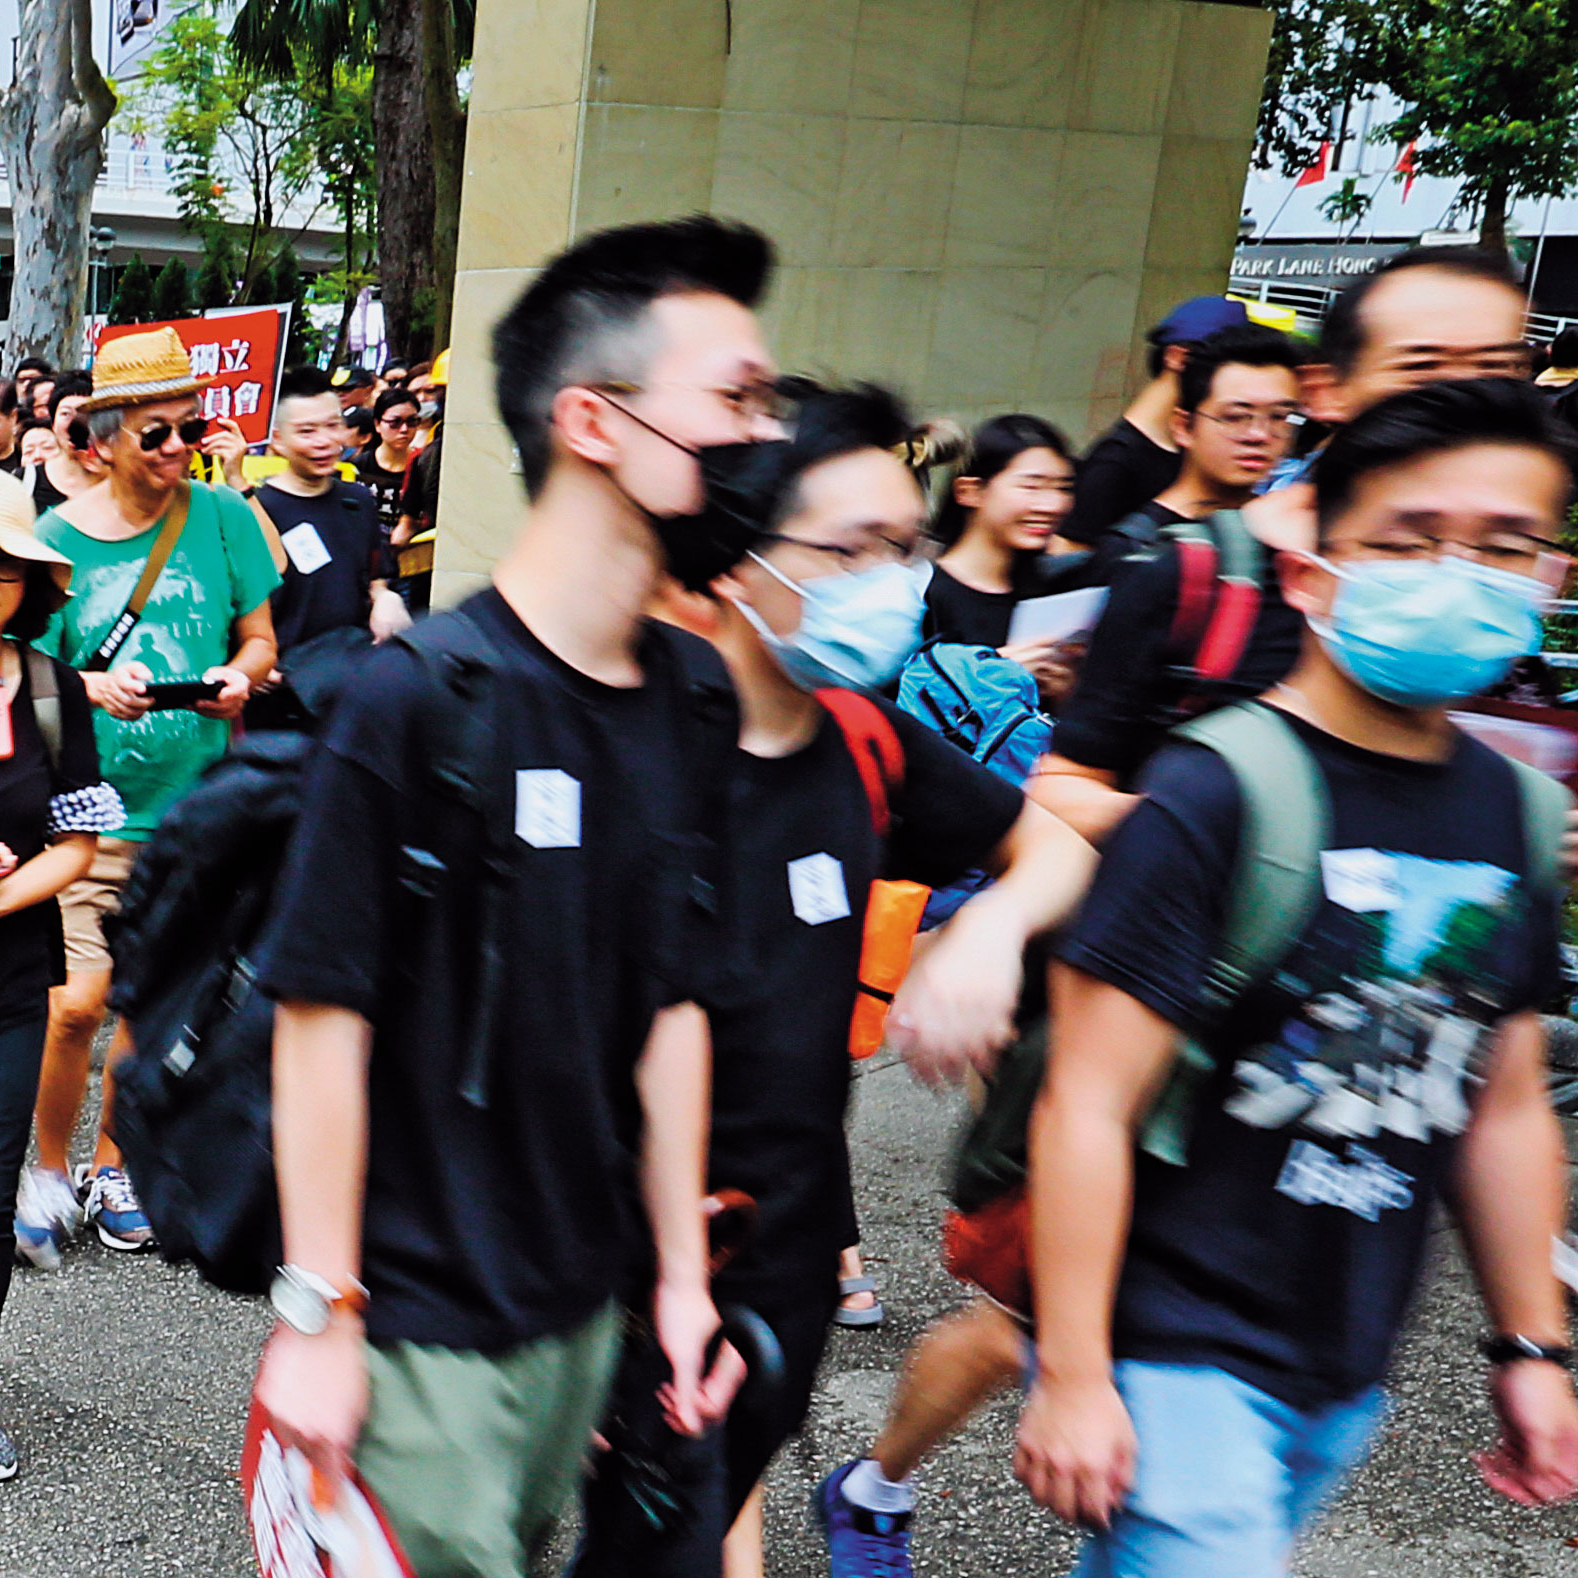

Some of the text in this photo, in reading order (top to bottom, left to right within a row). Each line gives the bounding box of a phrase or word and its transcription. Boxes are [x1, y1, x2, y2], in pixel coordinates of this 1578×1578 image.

[1230, 256, 1274, 276] PARK
[189, 338, 251, 377] 獨立
[200, 381, 263, 420] 員會
